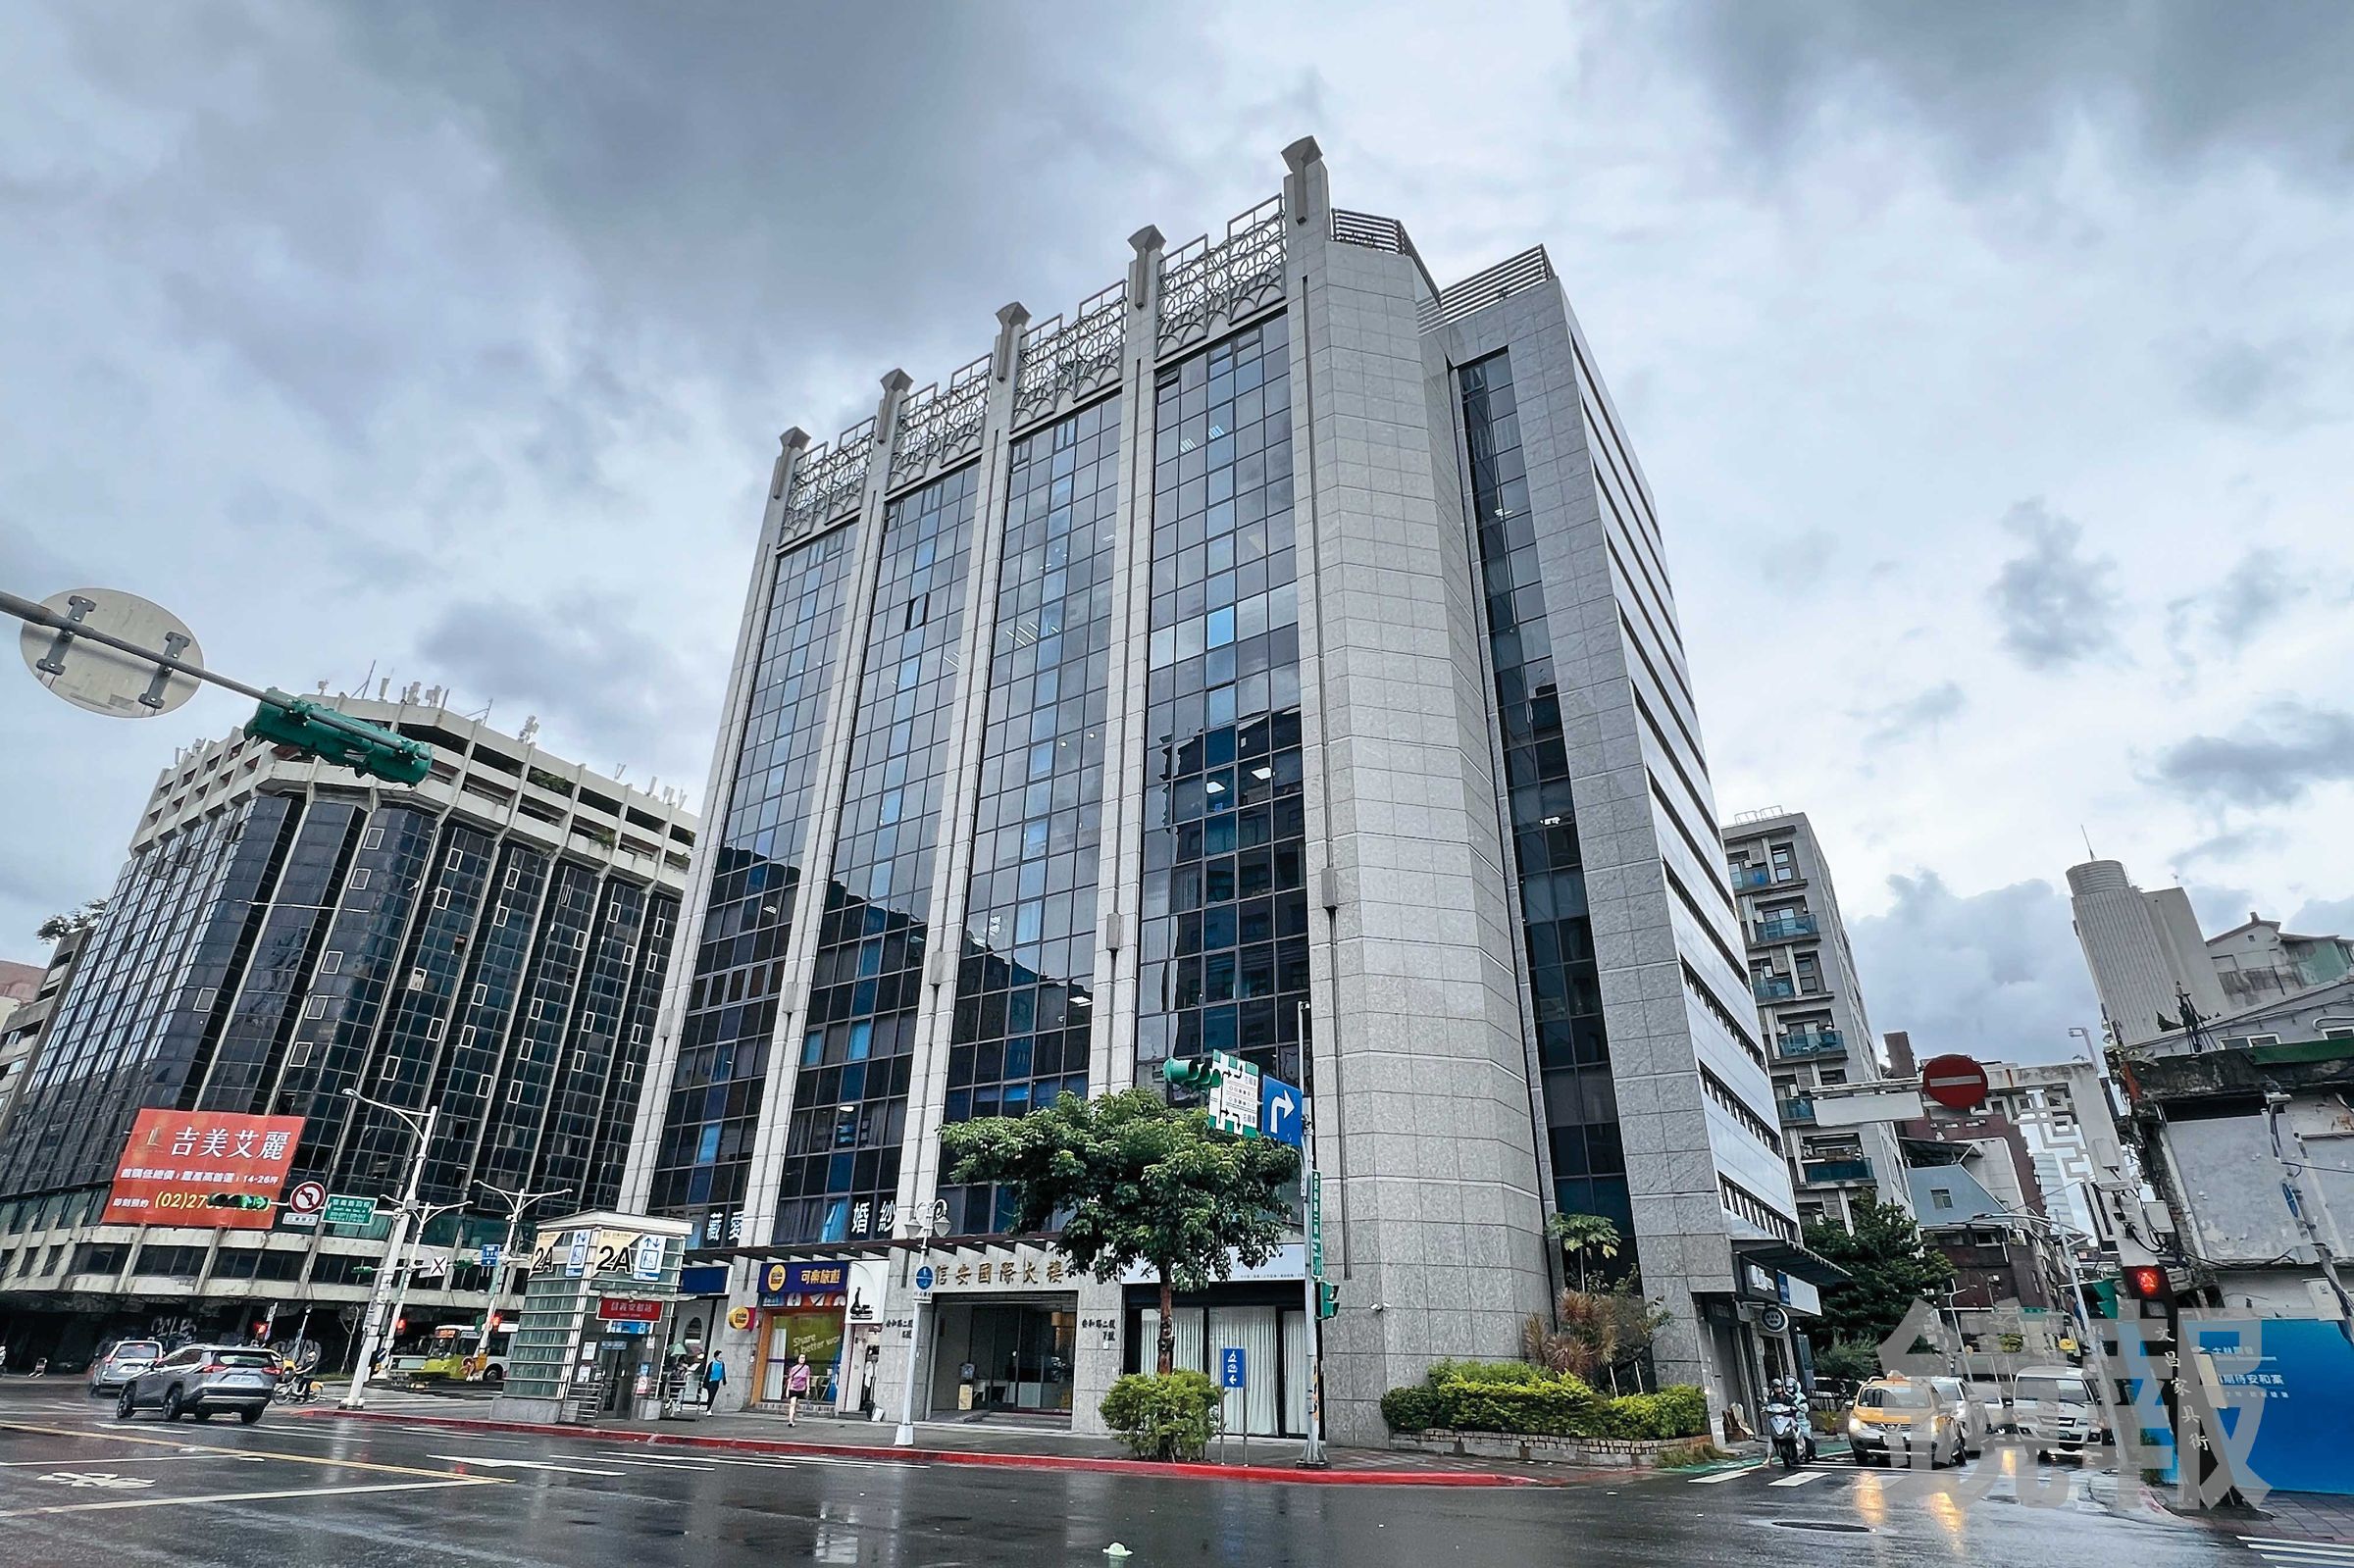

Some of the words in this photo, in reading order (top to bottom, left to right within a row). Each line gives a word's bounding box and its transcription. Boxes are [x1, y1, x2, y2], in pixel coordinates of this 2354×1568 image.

[171, 1127, 291, 1161] 吉美艾麗
[850, 1200, 896, 1235] 婚紗
[532, 1246, 553, 1272] 2A
[596, 1245, 632, 1272] 2A
[793, 1334, 816, 1347] Share
[800, 1340, 825, 1355] better
[2155, 1327, 2209, 1450] 文昌家具街
